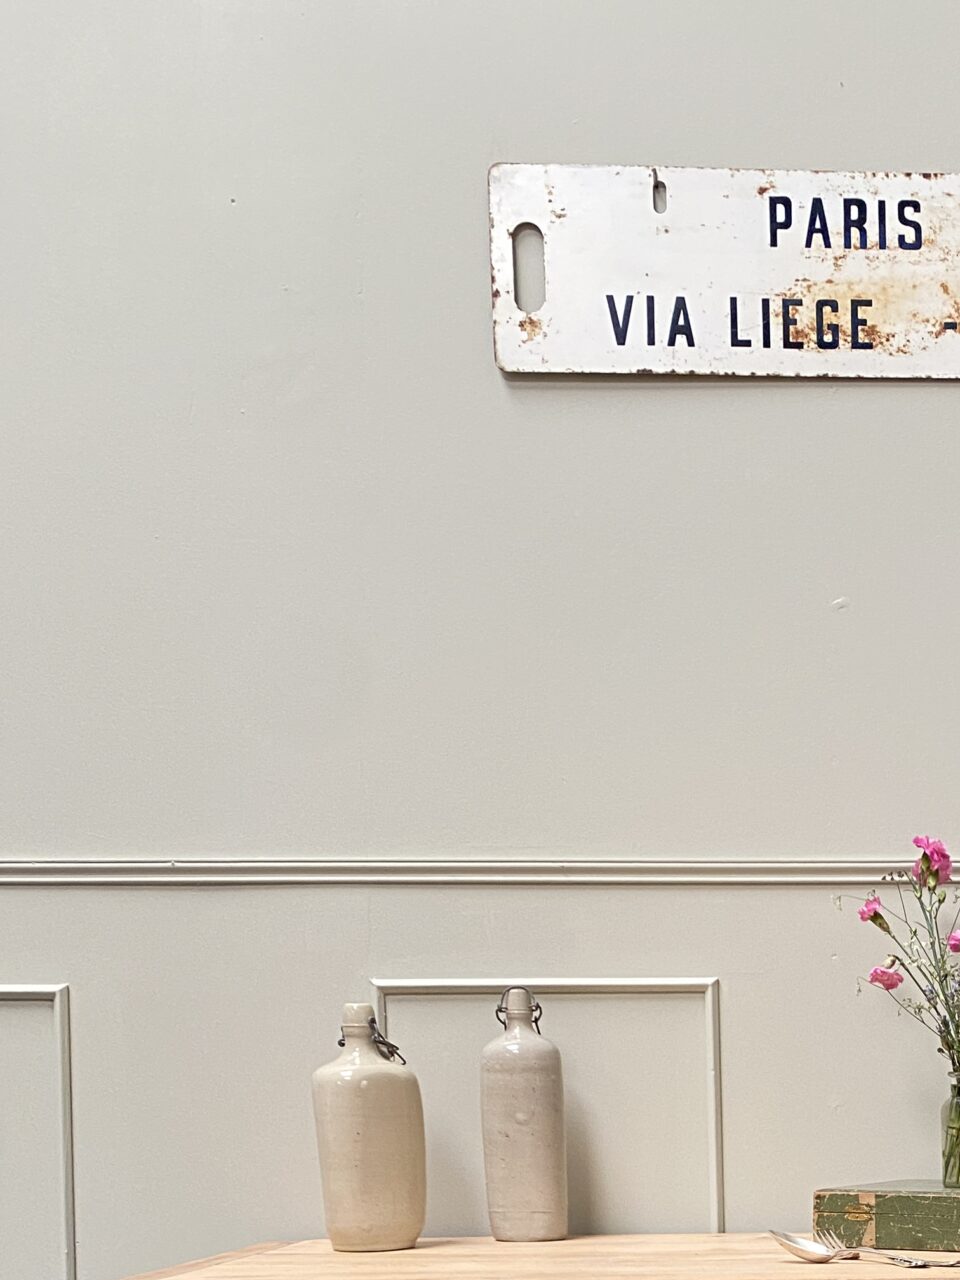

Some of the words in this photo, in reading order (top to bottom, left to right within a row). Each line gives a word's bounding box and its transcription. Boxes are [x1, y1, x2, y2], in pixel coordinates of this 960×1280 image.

[768, 196, 923, 251] PARIS
[605, 294, 696, 348] VIA
[729, 296, 874, 350] LIEGE
